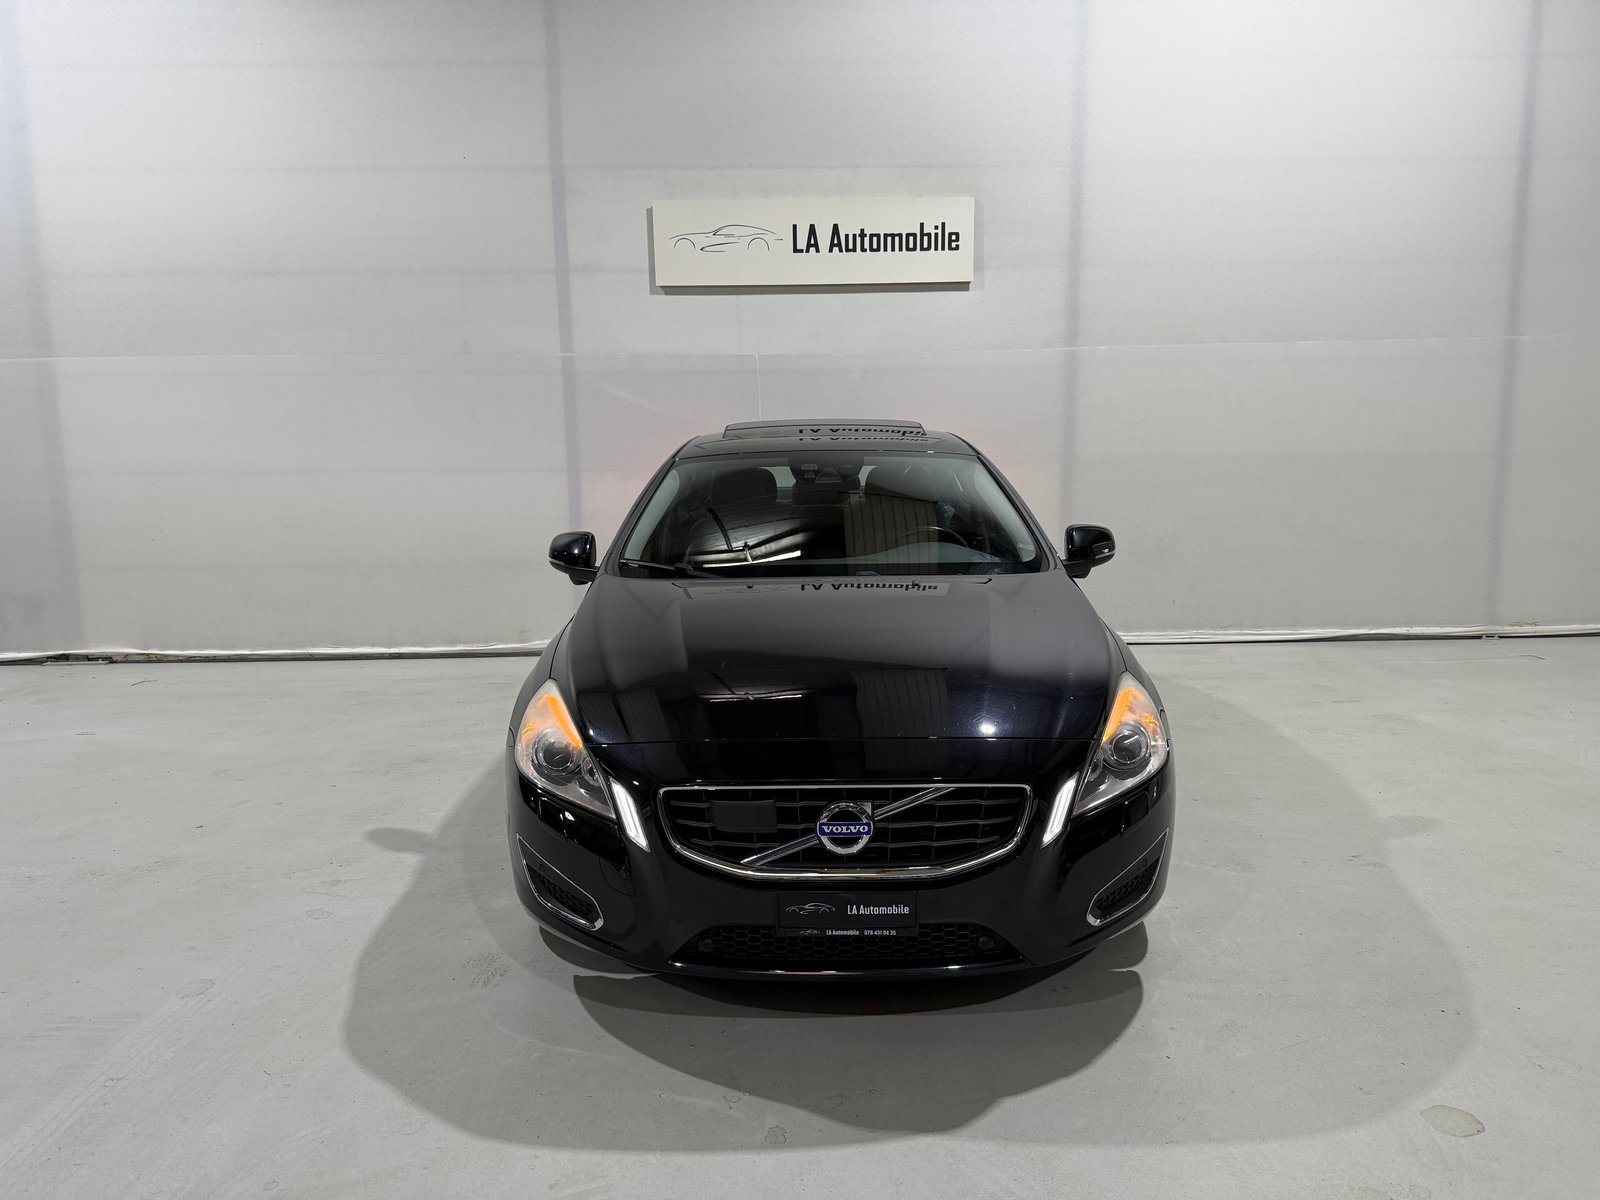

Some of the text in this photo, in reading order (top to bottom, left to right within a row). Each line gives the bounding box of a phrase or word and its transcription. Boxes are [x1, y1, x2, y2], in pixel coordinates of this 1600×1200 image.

[792, 222, 960, 253] LA Automobile
[821, 825, 869, 833] VOLVO
[847, 904, 910, 915] LA Automobile
